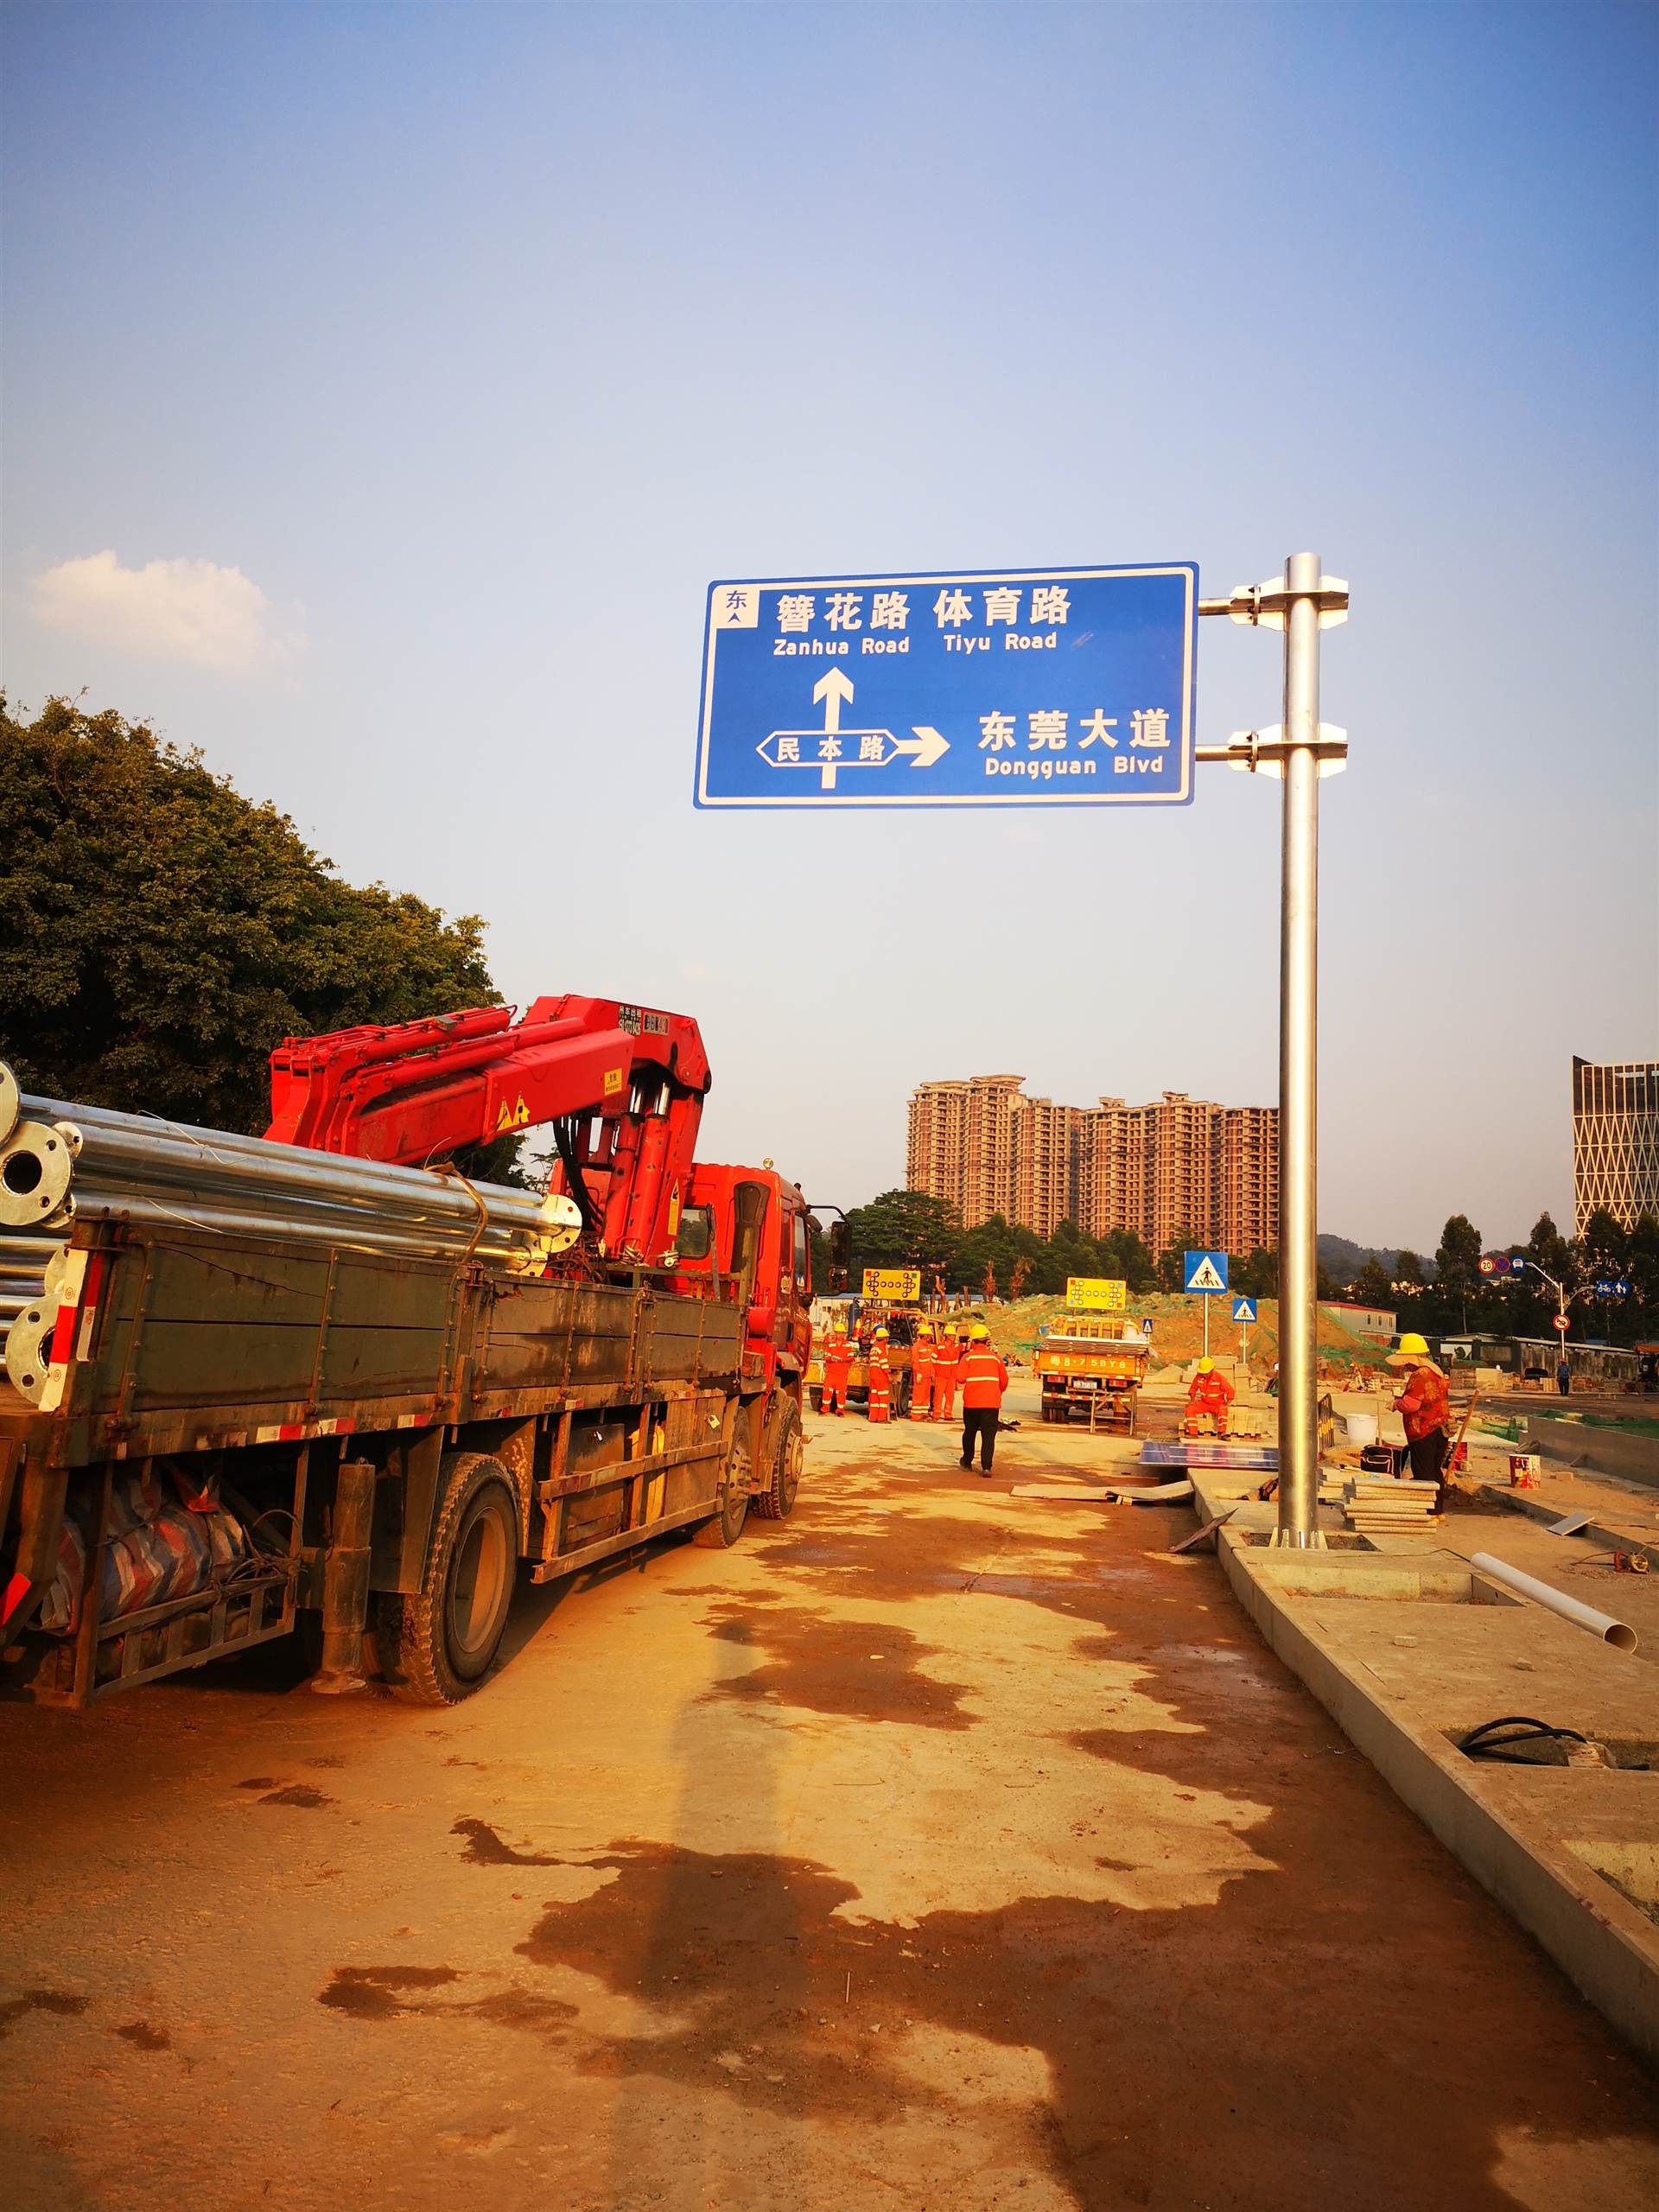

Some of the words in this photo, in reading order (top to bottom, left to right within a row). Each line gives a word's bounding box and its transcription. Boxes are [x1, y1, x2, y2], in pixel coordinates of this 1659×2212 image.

[726, 590, 747, 610] 东
[777, 591, 911, 632] 簪花路
[932, 585, 1071, 628] 体育路
[773, 638, 849, 655] Zanhua
[861, 636, 910, 654] Road
[944, 633, 990, 654] Tiyu
[1005, 632, 1057, 650] Road
[978, 708, 1171, 751] 东莞大道
[777, 735, 885, 762] 民本路
[985, 757, 1096, 779] Dongguan
[1114, 755, 1163, 774] Blvd
